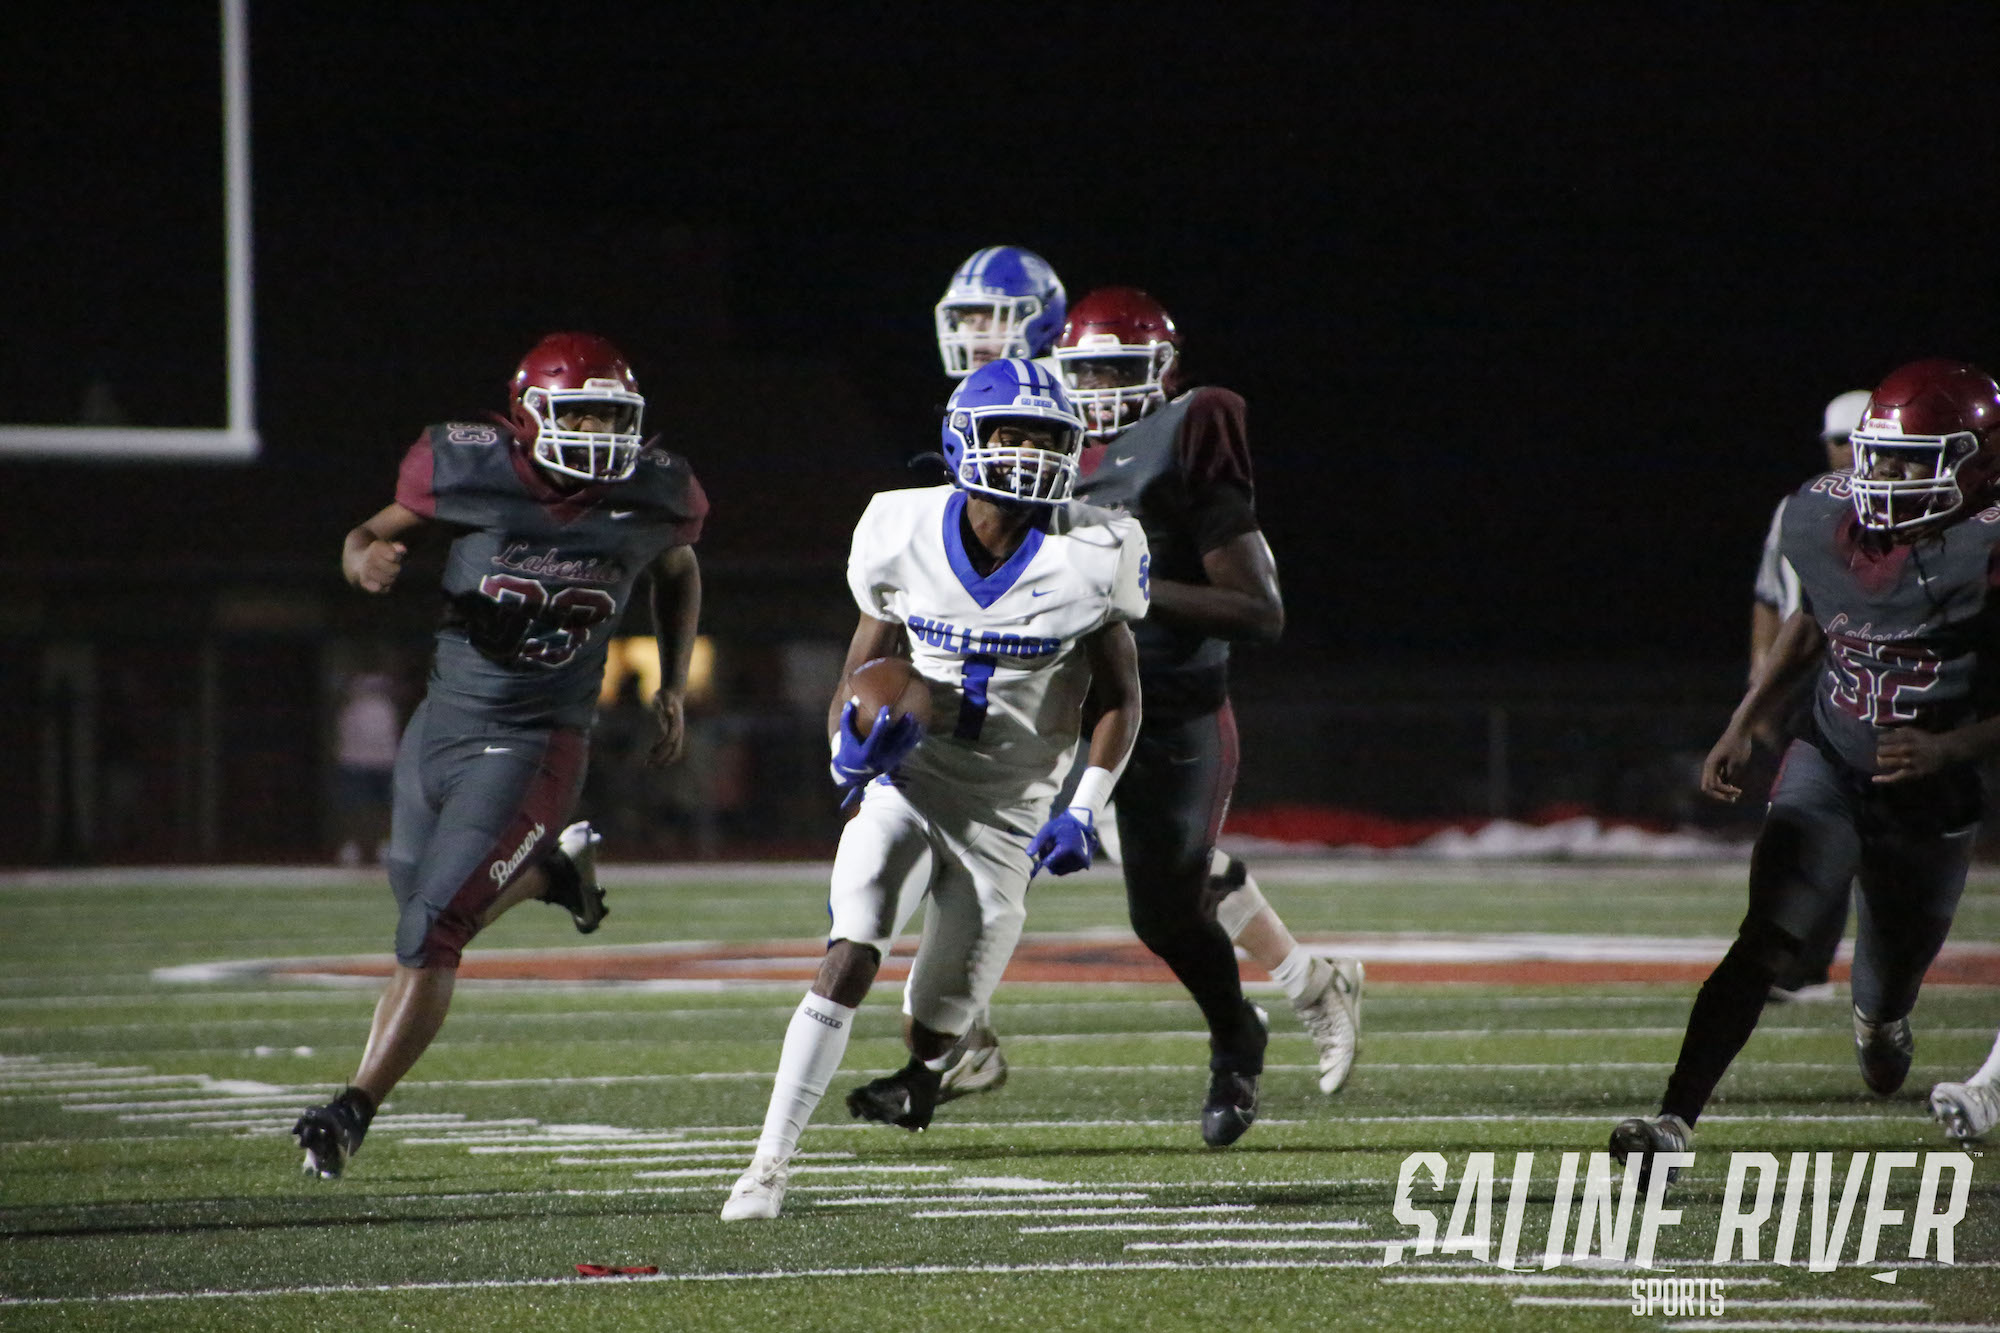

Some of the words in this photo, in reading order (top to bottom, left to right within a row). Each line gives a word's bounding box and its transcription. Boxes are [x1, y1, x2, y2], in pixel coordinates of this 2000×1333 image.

[907, 615, 1062, 659] BULLDOGS
[954, 654, 997, 740] 1
[1829, 633, 1942, 728] 52
[489, 822, 545, 891] Beavers
